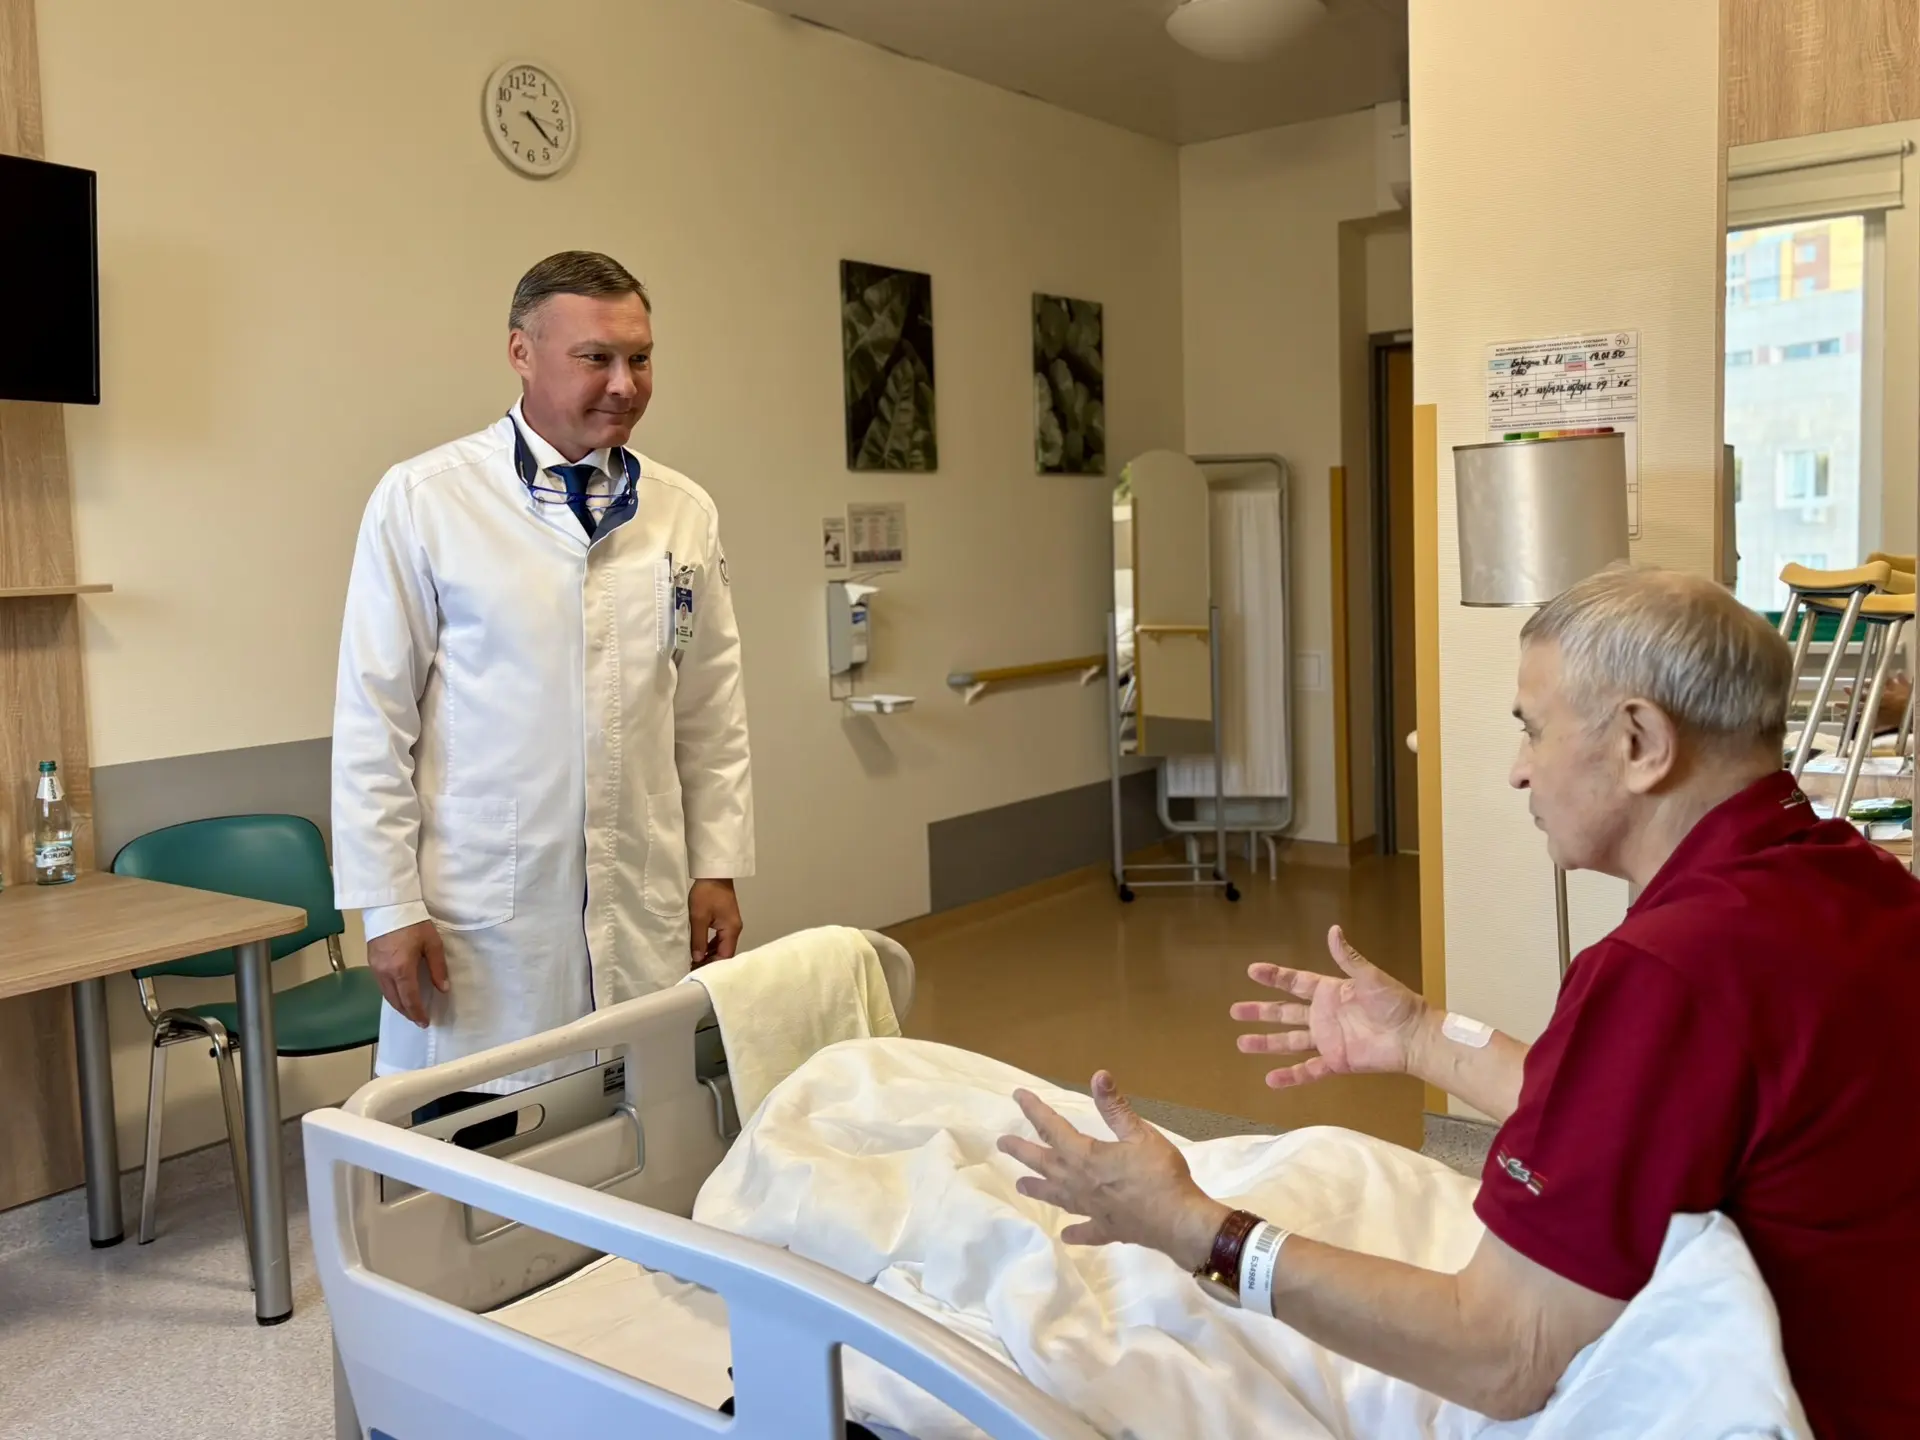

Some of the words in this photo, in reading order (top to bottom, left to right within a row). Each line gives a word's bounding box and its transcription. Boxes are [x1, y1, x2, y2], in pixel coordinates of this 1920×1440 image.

[509, 74, 520, 89] 11
[523, 72, 536, 87] 12
[498, 87, 512, 102] 10
[541, 82, 548, 97] 1
[496, 104, 503, 117] 9
[552, 99, 560, 113] 2
[500, 123, 508, 137] 8
[556, 118, 564, 132] 3
[512, 140, 520, 153] 7
[551, 136, 559, 148] 4
[527, 149, 536, 163] 6
[542, 148, 550, 161] 5
